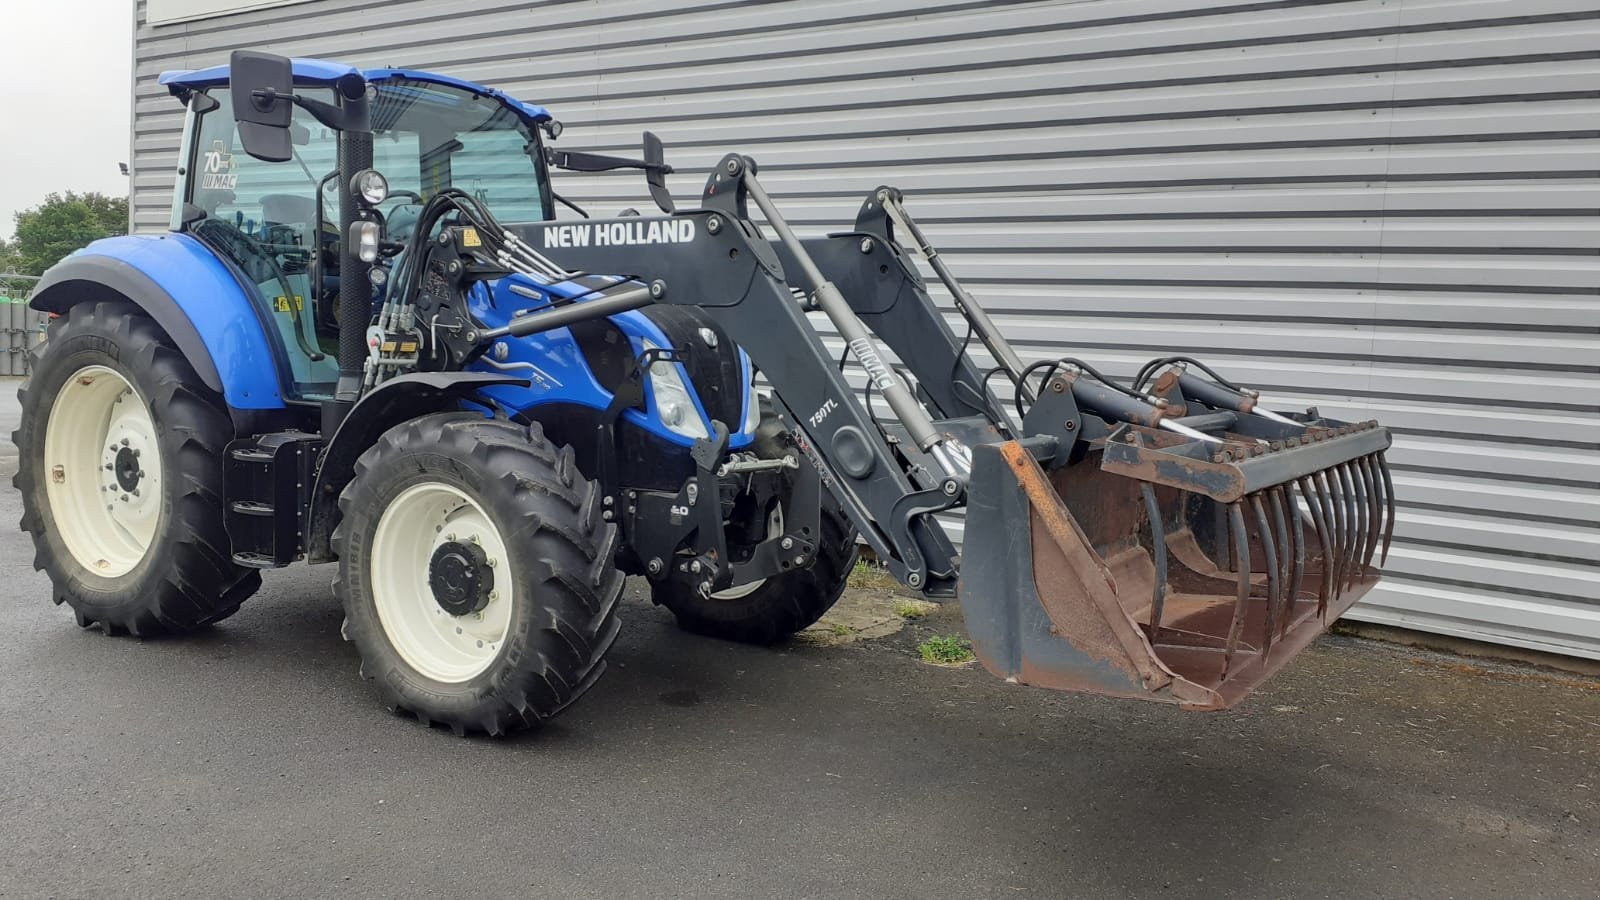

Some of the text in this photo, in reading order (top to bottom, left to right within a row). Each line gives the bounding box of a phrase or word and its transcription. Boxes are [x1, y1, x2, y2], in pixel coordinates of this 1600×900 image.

[204, 152, 220, 173] 70
[544, 219, 696, 248] NEW HOLLAND
[809, 398, 839, 428] 750TL
